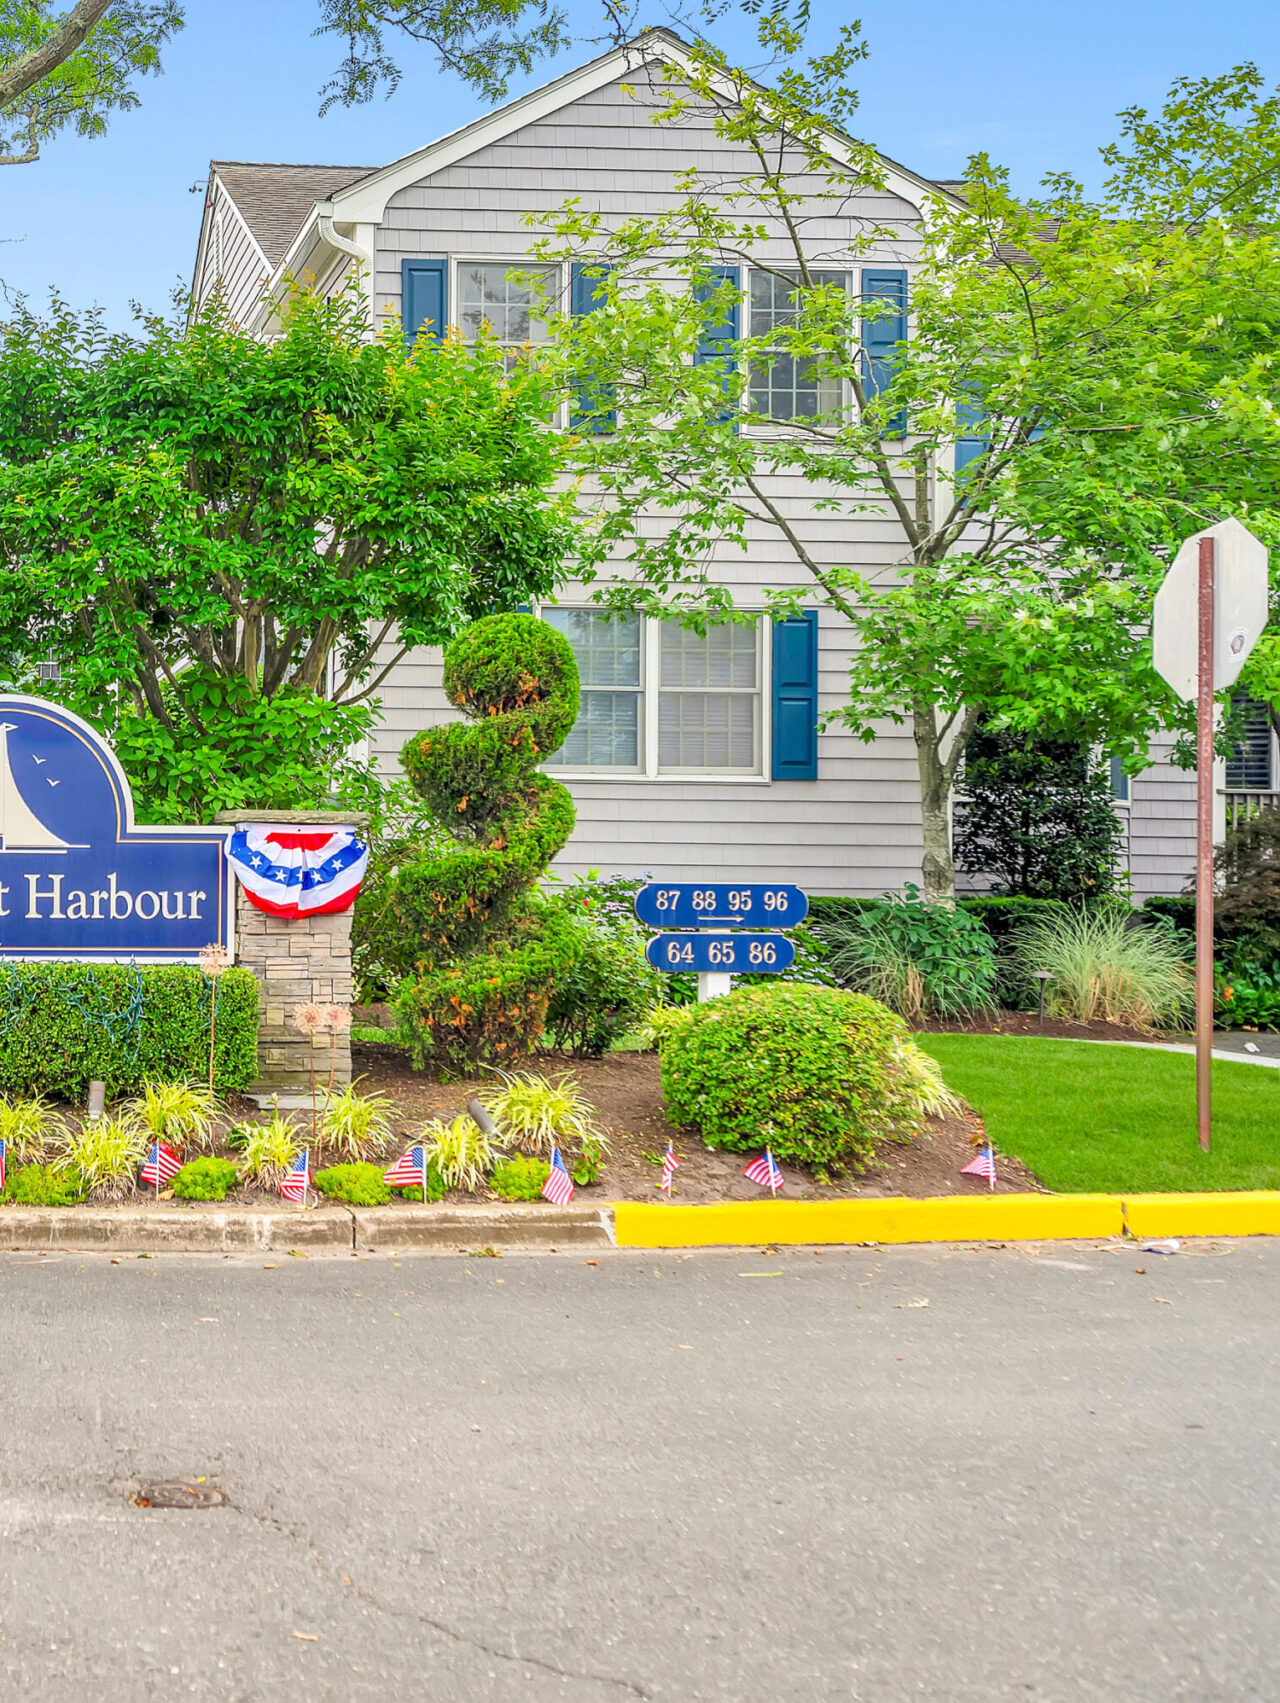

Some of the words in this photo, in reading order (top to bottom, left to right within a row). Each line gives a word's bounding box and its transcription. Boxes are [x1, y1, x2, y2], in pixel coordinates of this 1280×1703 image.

[24, 872, 207, 920] Harbour
[655, 890, 681, 911] 87
[691, 890, 717, 911] 88
[727, 890, 753, 912] 95
[763, 891, 789, 912] 96
[667, 941, 695, 964] 64
[708, 941, 736, 964] 65
[749, 942, 777, 964] 86
